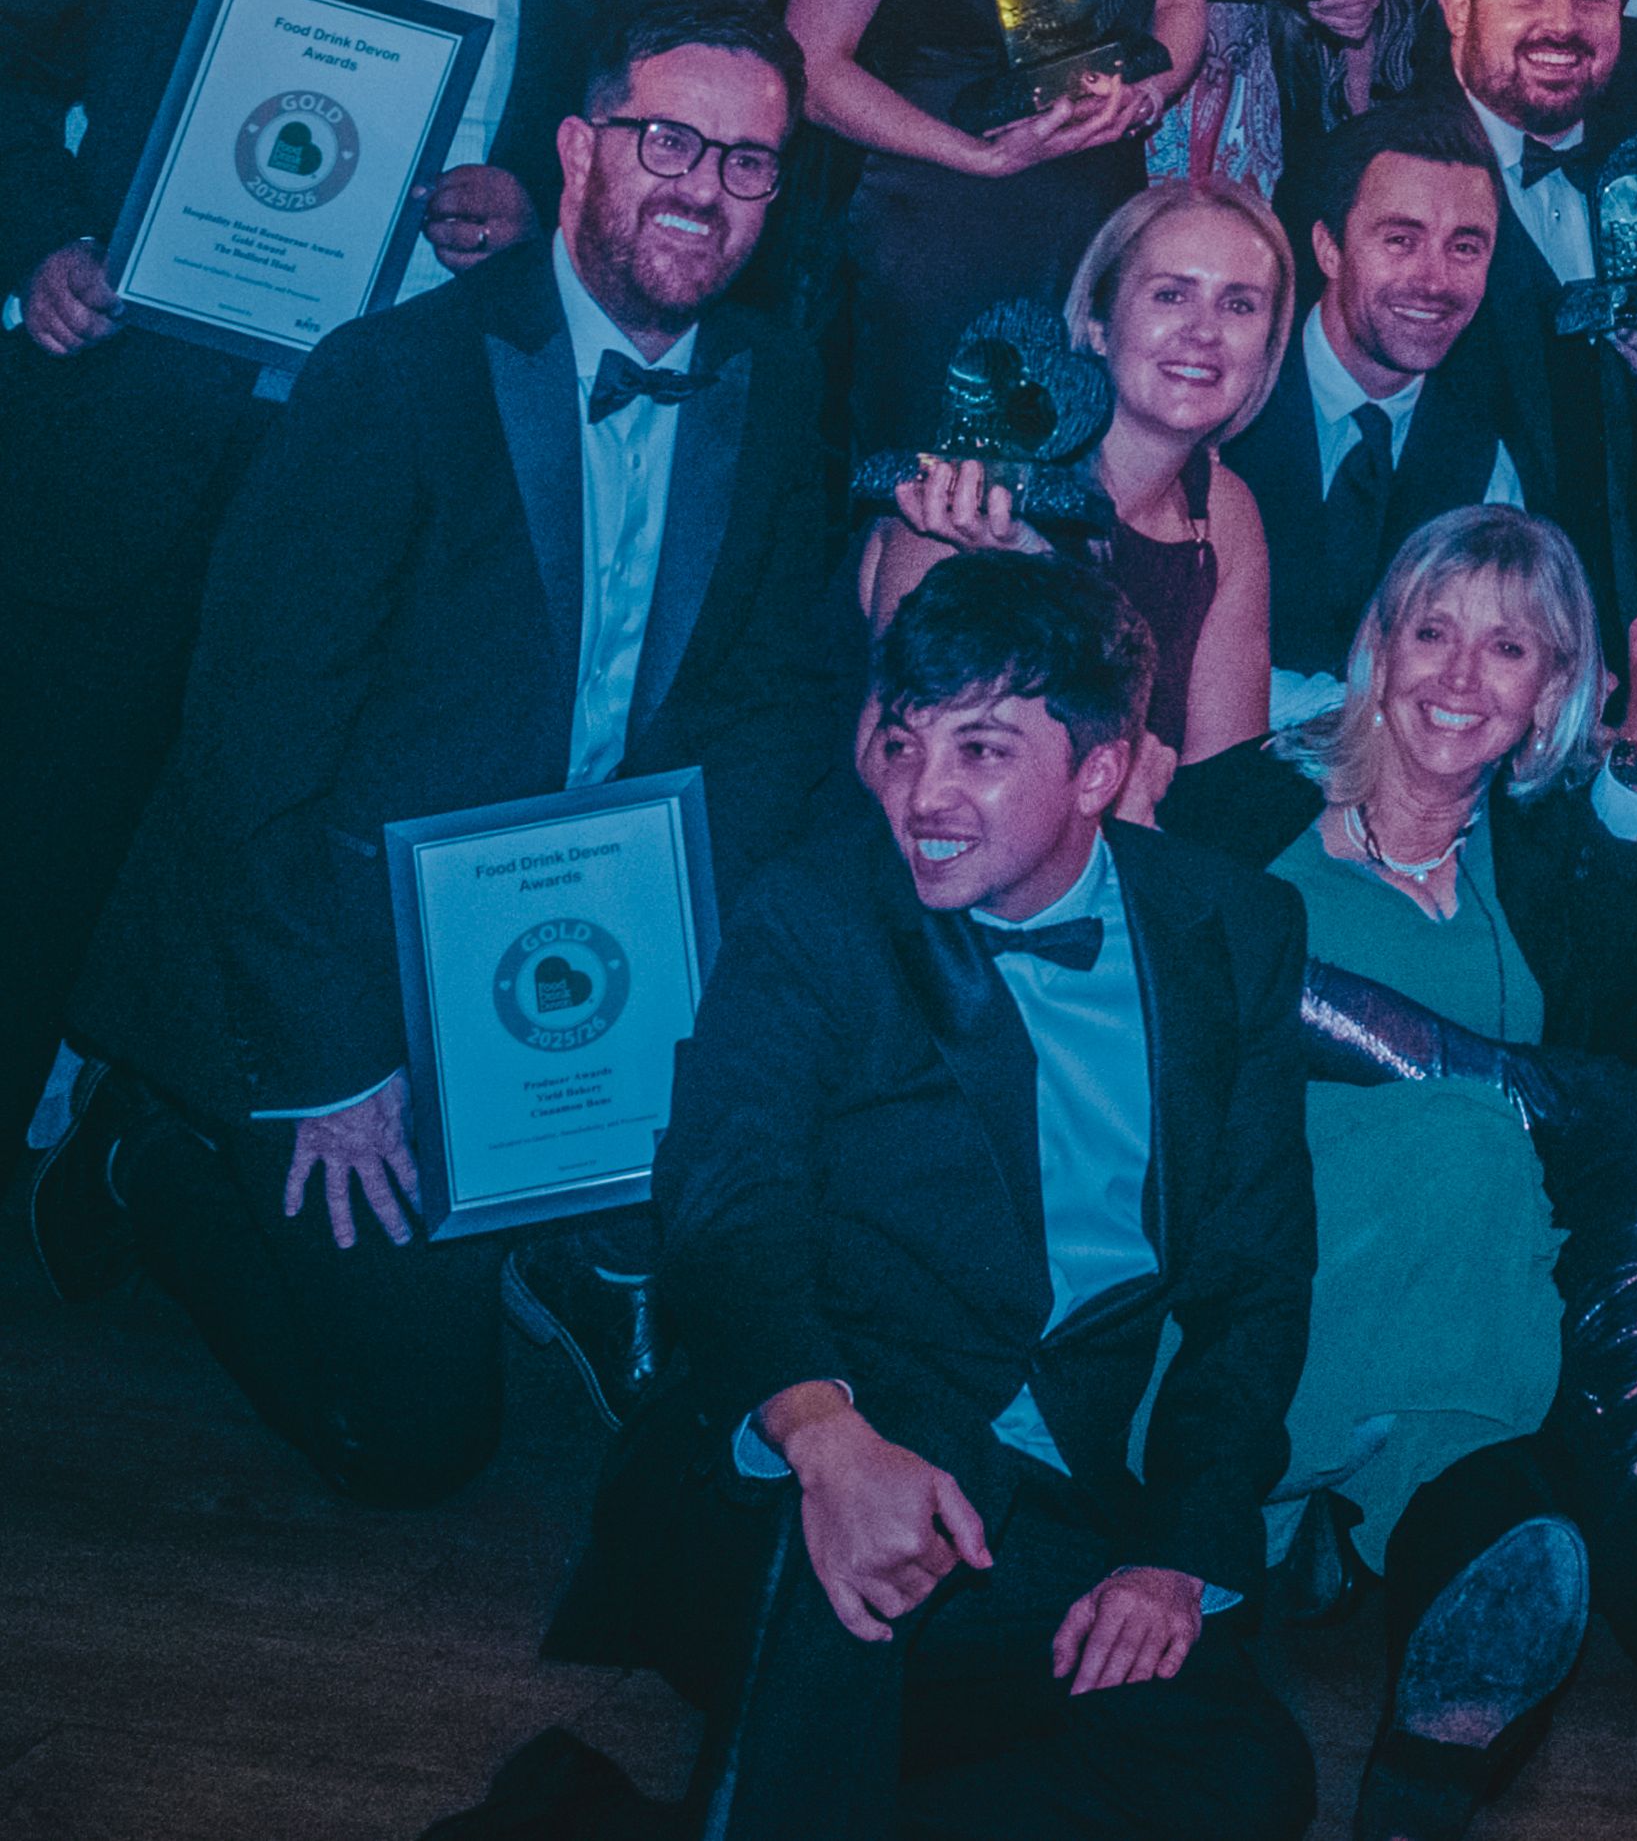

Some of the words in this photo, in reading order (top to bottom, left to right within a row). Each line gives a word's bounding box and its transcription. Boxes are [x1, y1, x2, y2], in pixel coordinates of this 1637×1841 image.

[273, 15, 312, 37] Food
[312, 26, 352, 48] Drink
[353, 38, 401, 62] Devon
[301, 45, 358, 72] Awards
[280, 93, 346, 125] GOLD
[244, 176, 318, 209] 2025/26
[181, 204, 231, 227] Hospitality
[231, 219, 259, 234] Hotel
[257, 226, 309, 248] Restaurant
[309, 242, 345, 258] Awards
[230, 232, 255, 247] Gold
[254, 241, 287, 256] Award
[213, 242, 232, 254] The
[269, 257, 297, 273] Hotel
[474, 858, 517, 879] Food
[519, 850, 565, 871] Drink
[567, 841, 621, 862] Devon
[517, 869, 582, 893] Awards
[520, 921, 593, 953] GOLD
[525, 1015, 607, 1050] 2025/26
[522, 1075, 570, 1091] Producer
[573, 1066, 613, 1080] Awards
